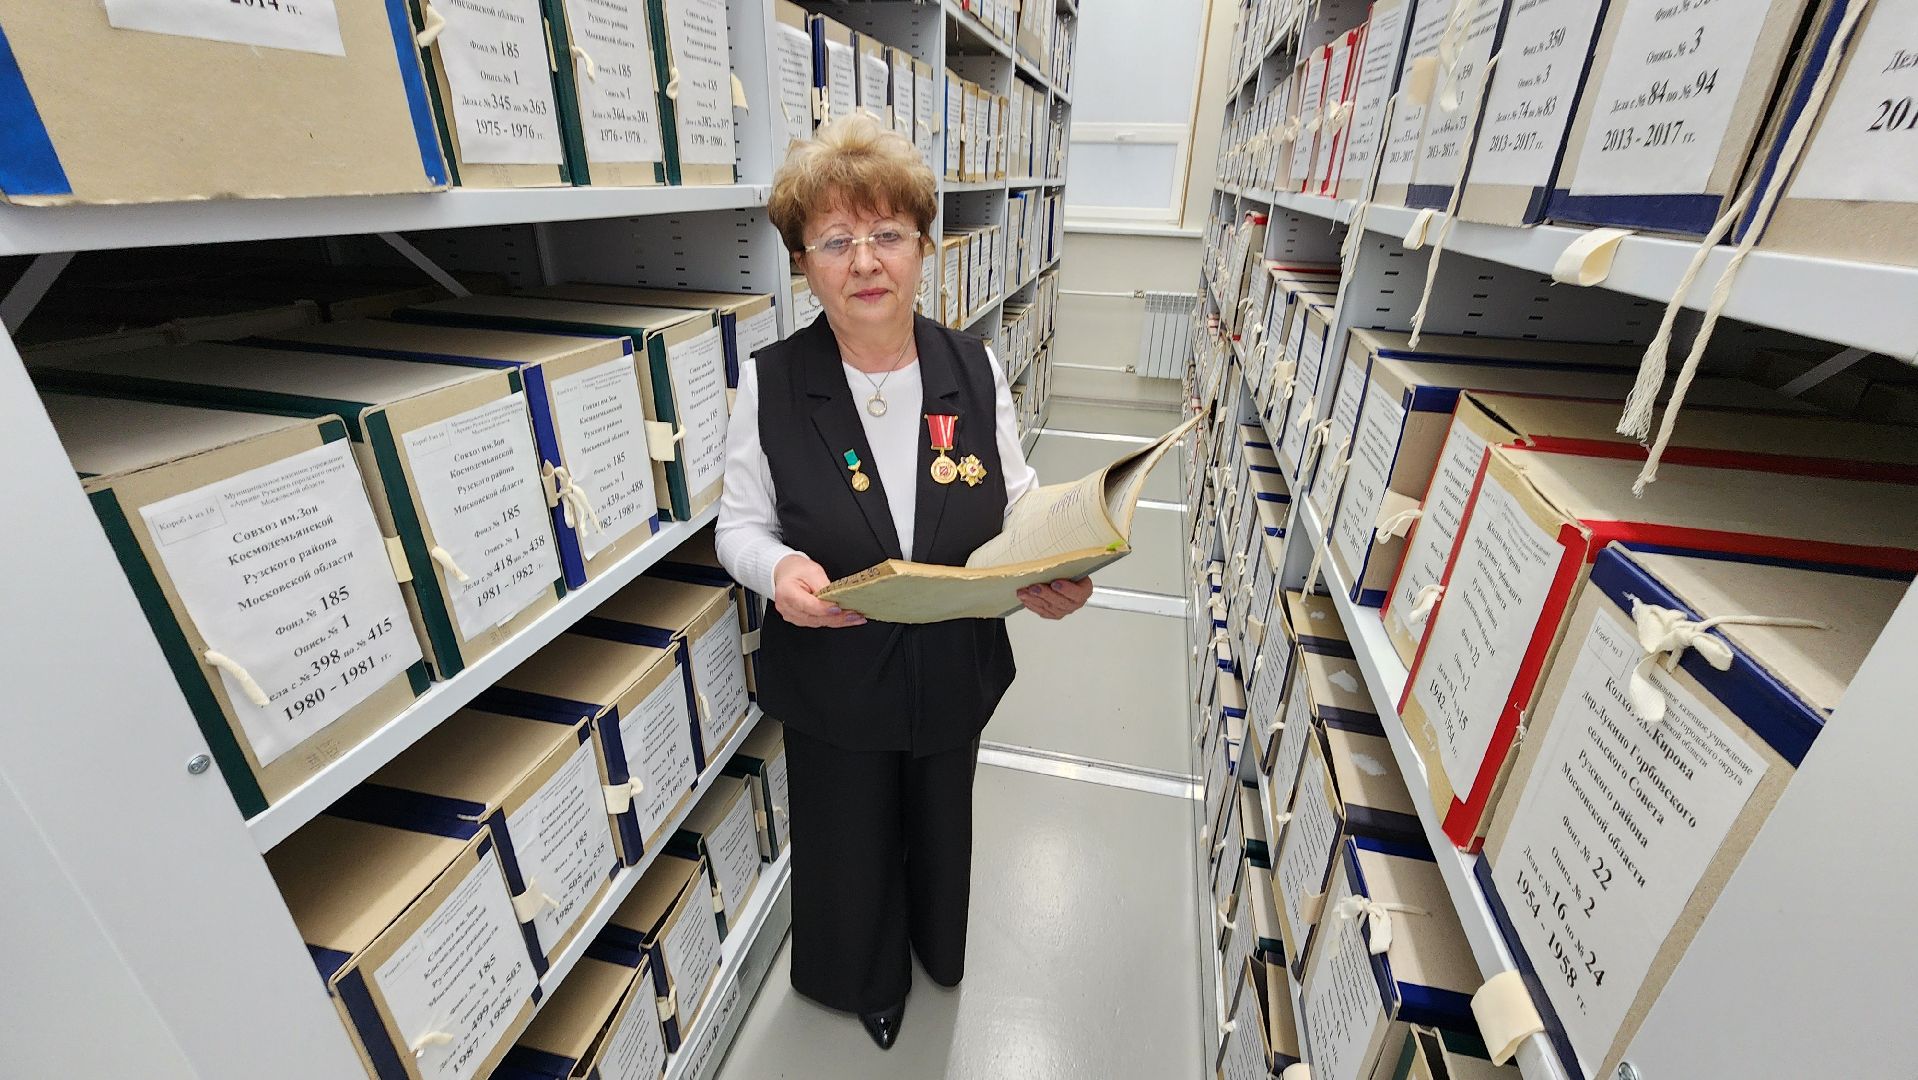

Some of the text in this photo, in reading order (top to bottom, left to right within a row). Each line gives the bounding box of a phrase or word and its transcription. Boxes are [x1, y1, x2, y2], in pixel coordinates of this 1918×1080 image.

[501, 41, 519, 58] 185
[1544, 26, 1566, 51] 350
[1646, 26, 1704, 64] Опись 3
[618, 63, 631, 78] 185
[1541, 63, 1552, 84] 3
[491, 93, 511, 111] 345
[528, 98, 547, 115] 363
[1542, 95, 1557, 116] 83
[1609, 67, 1719, 115] Дела 84 94
[476, 118, 535, 139] 1975 1976
[600, 128, 641, 143] 1976 1978
[1488, 134, 1508, 152] 2013
[1512, 131, 1537, 151] 2017
[1601, 126, 1634, 152] 2013
[1643, 119, 1684, 147] 2017
[490, 465, 514, 482] района
[613, 451, 625, 466] 185
[453, 477, 524, 516] Московской области
[607, 479, 643, 507] 439 488
[158, 516, 187, 531] Короб
[205, 506, 215, 515] 16
[502, 504, 520, 523] 185
[598, 515, 612, 529] 982
[228, 514, 333, 566] Космодемьянской
[232, 522, 278, 543] Совхоз
[243, 538, 337, 584] Рузского района
[493, 554, 513, 572] 418
[529, 534, 545, 551] 438
[237, 551, 353, 609] Московской области
[477, 563, 533, 607] 1981 1982
[275, 585, 349, 635] Фонд № 185
[293, 614, 349, 657] Опись № 1
[269, 687, 289, 702] ела
[299, 673, 310, 686] №
[310, 649, 340, 676] 398
[356, 639, 366, 651] №
[368, 617, 392, 640] 415
[1471, 646, 1480, 668] 22
[283, 688, 325, 720] 1980
[340, 656, 374, 686] 1981
[1429, 679, 1445, 709] 1942
[1463, 675, 1470, 692] 2
[1605, 676, 1634, 717] Колхо
[1458, 710, 1468, 731] 15
[1678, 703, 1753, 774] казенное учреждение
[1679, 720, 1743, 786] городского округа
[1681, 739, 1708, 767] области
[1581, 692, 1696, 828] дер.Лукино Горбовского
[1587, 725, 1664, 824] сельского Совета
[1578, 749, 1648, 848] Рузского района
[1561, 761, 1645, 888] Московской области
[1562, 815, 1612, 891] Фонд № 22
[1551, 846, 1595, 918] Опись № 2
[1516, 870, 1540, 918] 1954
[1548, 931, 1577, 988] 1958
[1523, 845, 1538, 874] Дела
[1542, 880, 1550, 896] №
[1552, 891, 1567, 920] 16
[1564, 923, 1574, 940] по
[1574, 939, 1584, 958] №
[1584, 951, 1605, 987] 24
[478, 953, 496, 979] 185
[490, 974, 496, 985] 1
[453, 995, 512, 1073] 1987 1988
